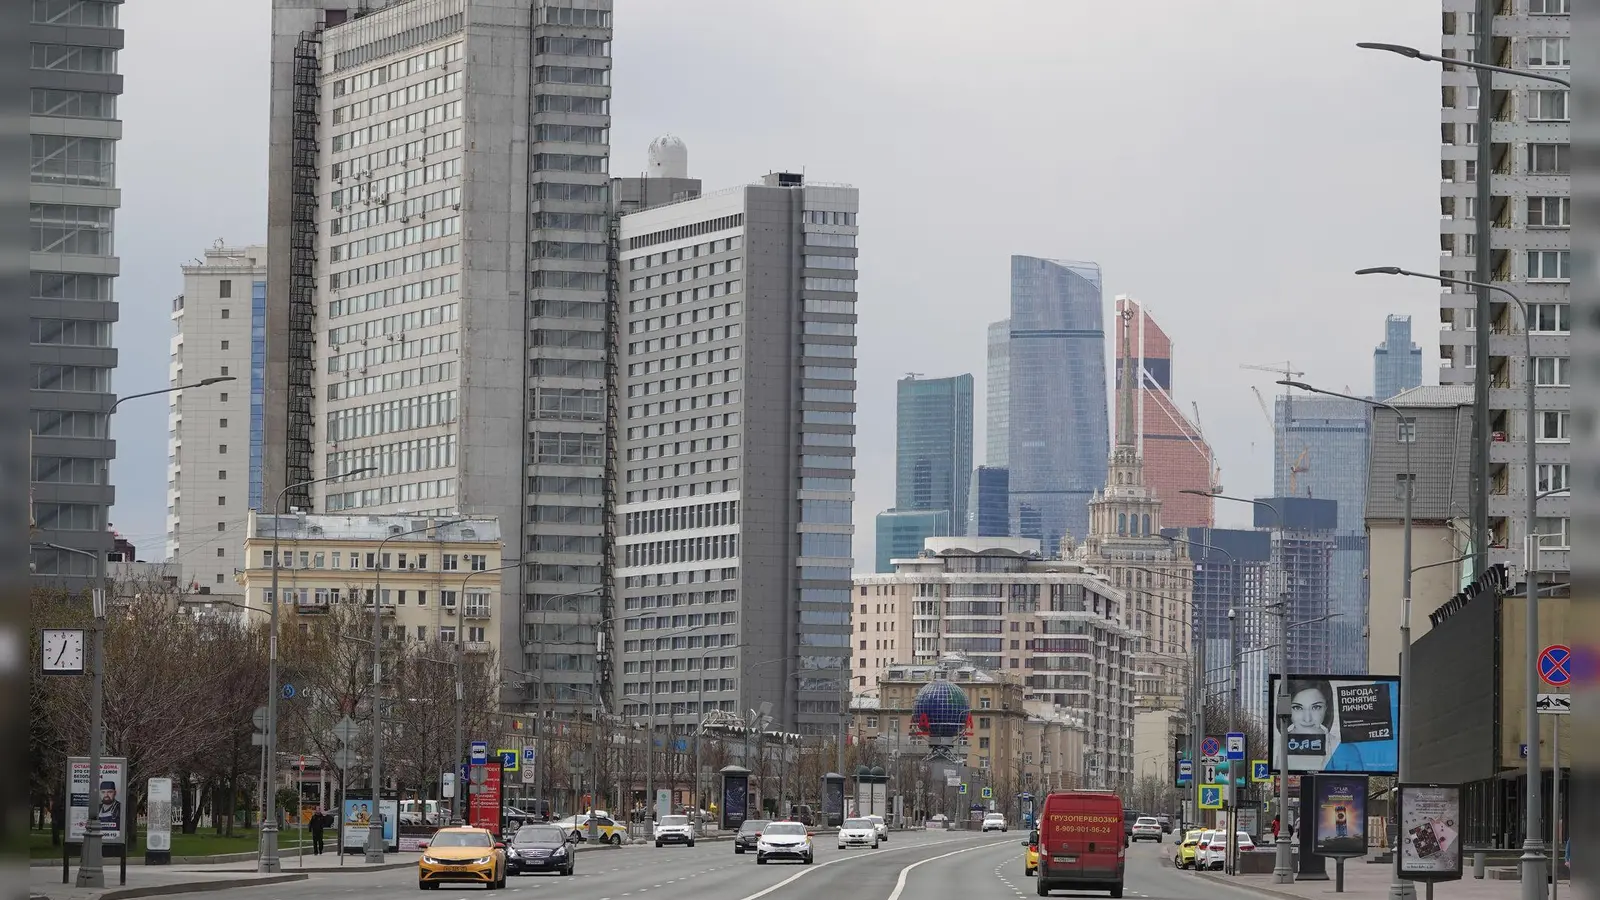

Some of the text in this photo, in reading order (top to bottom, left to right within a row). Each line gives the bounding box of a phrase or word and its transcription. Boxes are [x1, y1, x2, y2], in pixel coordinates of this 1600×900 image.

[1340, 688, 1374, 696] ВЫГОДА
[1342, 696, 1377, 704] ПОНЯТИЕ
[1342, 704, 1374, 712] ЛИЧНОЕ
[1368, 728, 1390, 738] TELE2
[1050, 815, 1118, 823] ГРУЗОПЕРЕВОЗКИ
